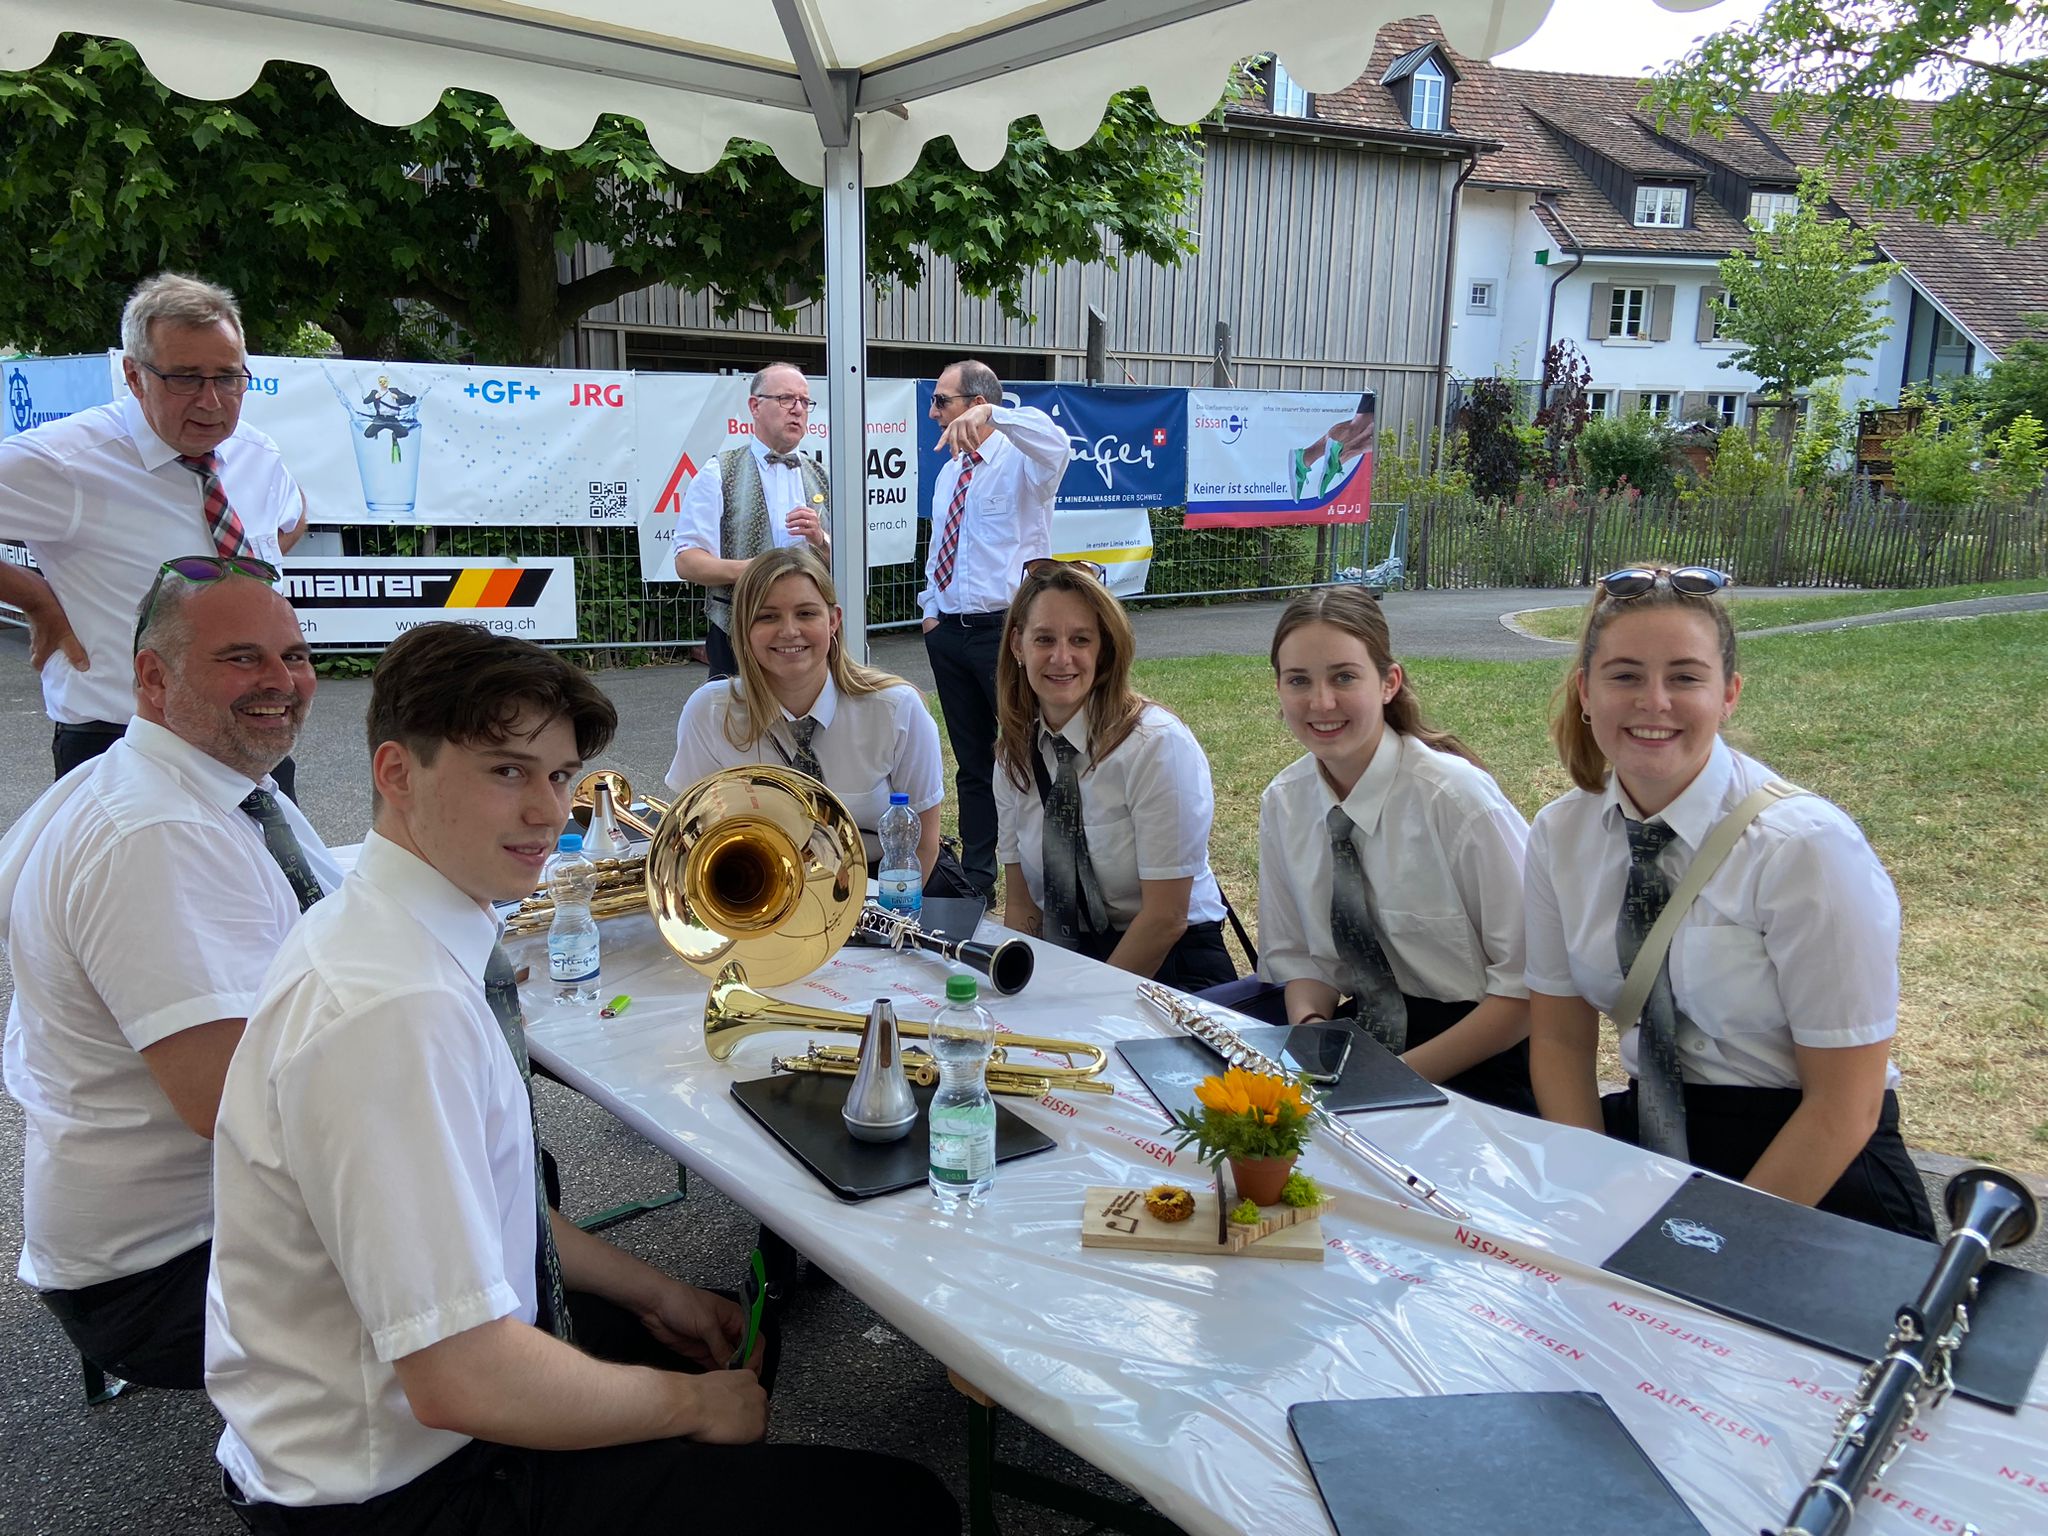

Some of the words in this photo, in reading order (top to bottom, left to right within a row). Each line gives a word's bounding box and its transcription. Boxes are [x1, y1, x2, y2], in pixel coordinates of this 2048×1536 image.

[569, 383, 624, 407] JRG
[1195, 414, 1248, 436] sissanet
[866, 447, 906, 479] AG
[868, 487, 907, 505] FBAU
[1064, 494, 1121, 504] MINERALWASSER
[1121, 494, 1135, 502] DER
[1136, 493, 1163, 501] SCHWEIZ
[1193, 482, 1225, 494] Keiner
[1227, 482, 1242, 494] ist
[1243, 481, 1288, 494] schneller.
[867, 517, 907, 531] erna.ch
[282, 575, 452, 598] maurer
[1327, 1238, 1427, 1286] RAIFFEISEN
[1454, 1226, 1561, 1283] RAIFFEISEN
[1467, 1303, 1586, 1361] RAIFFEISEN
[1608, 1300, 1731, 1357] RAIFFEISEN
[1636, 1380, 1774, 1448] RAIFFEISEN
